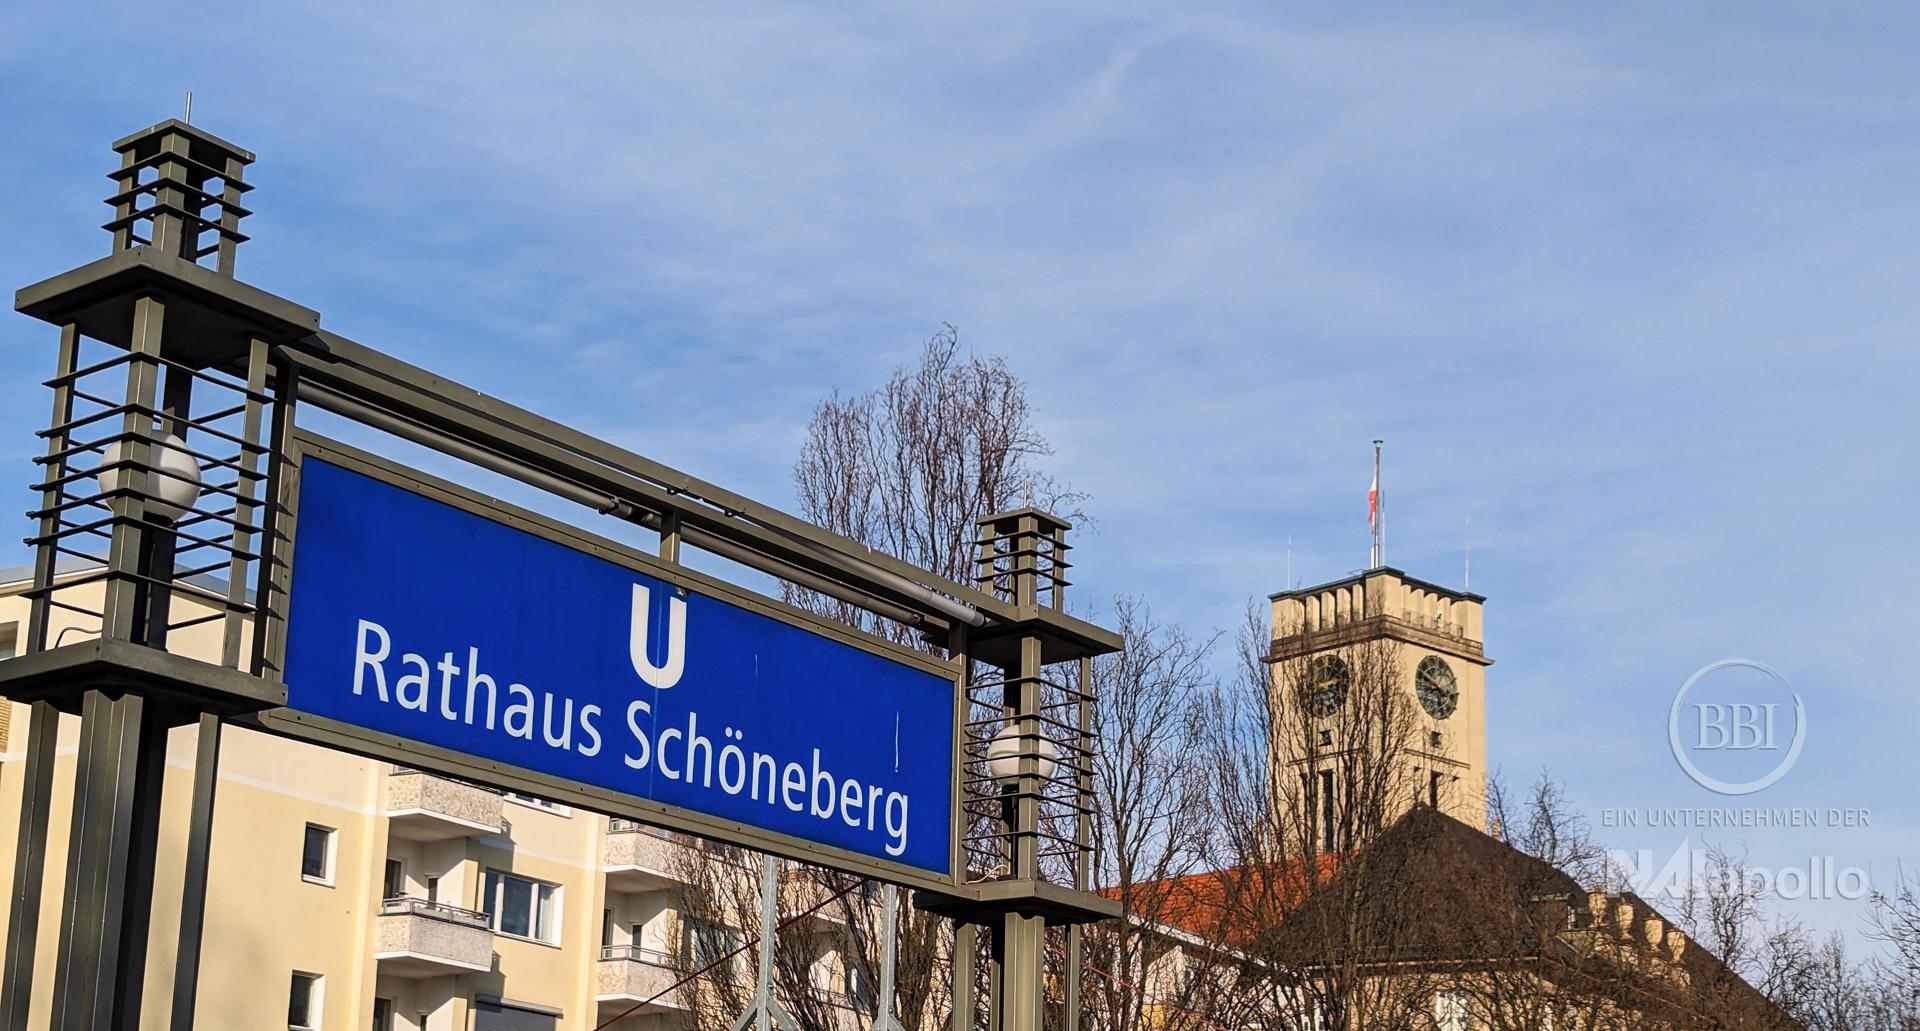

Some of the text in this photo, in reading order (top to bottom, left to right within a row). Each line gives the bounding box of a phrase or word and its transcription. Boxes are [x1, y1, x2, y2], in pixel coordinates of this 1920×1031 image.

[629, 583, 687, 689] U
[352, 618, 909, 857] Rathaus Schöneberg
